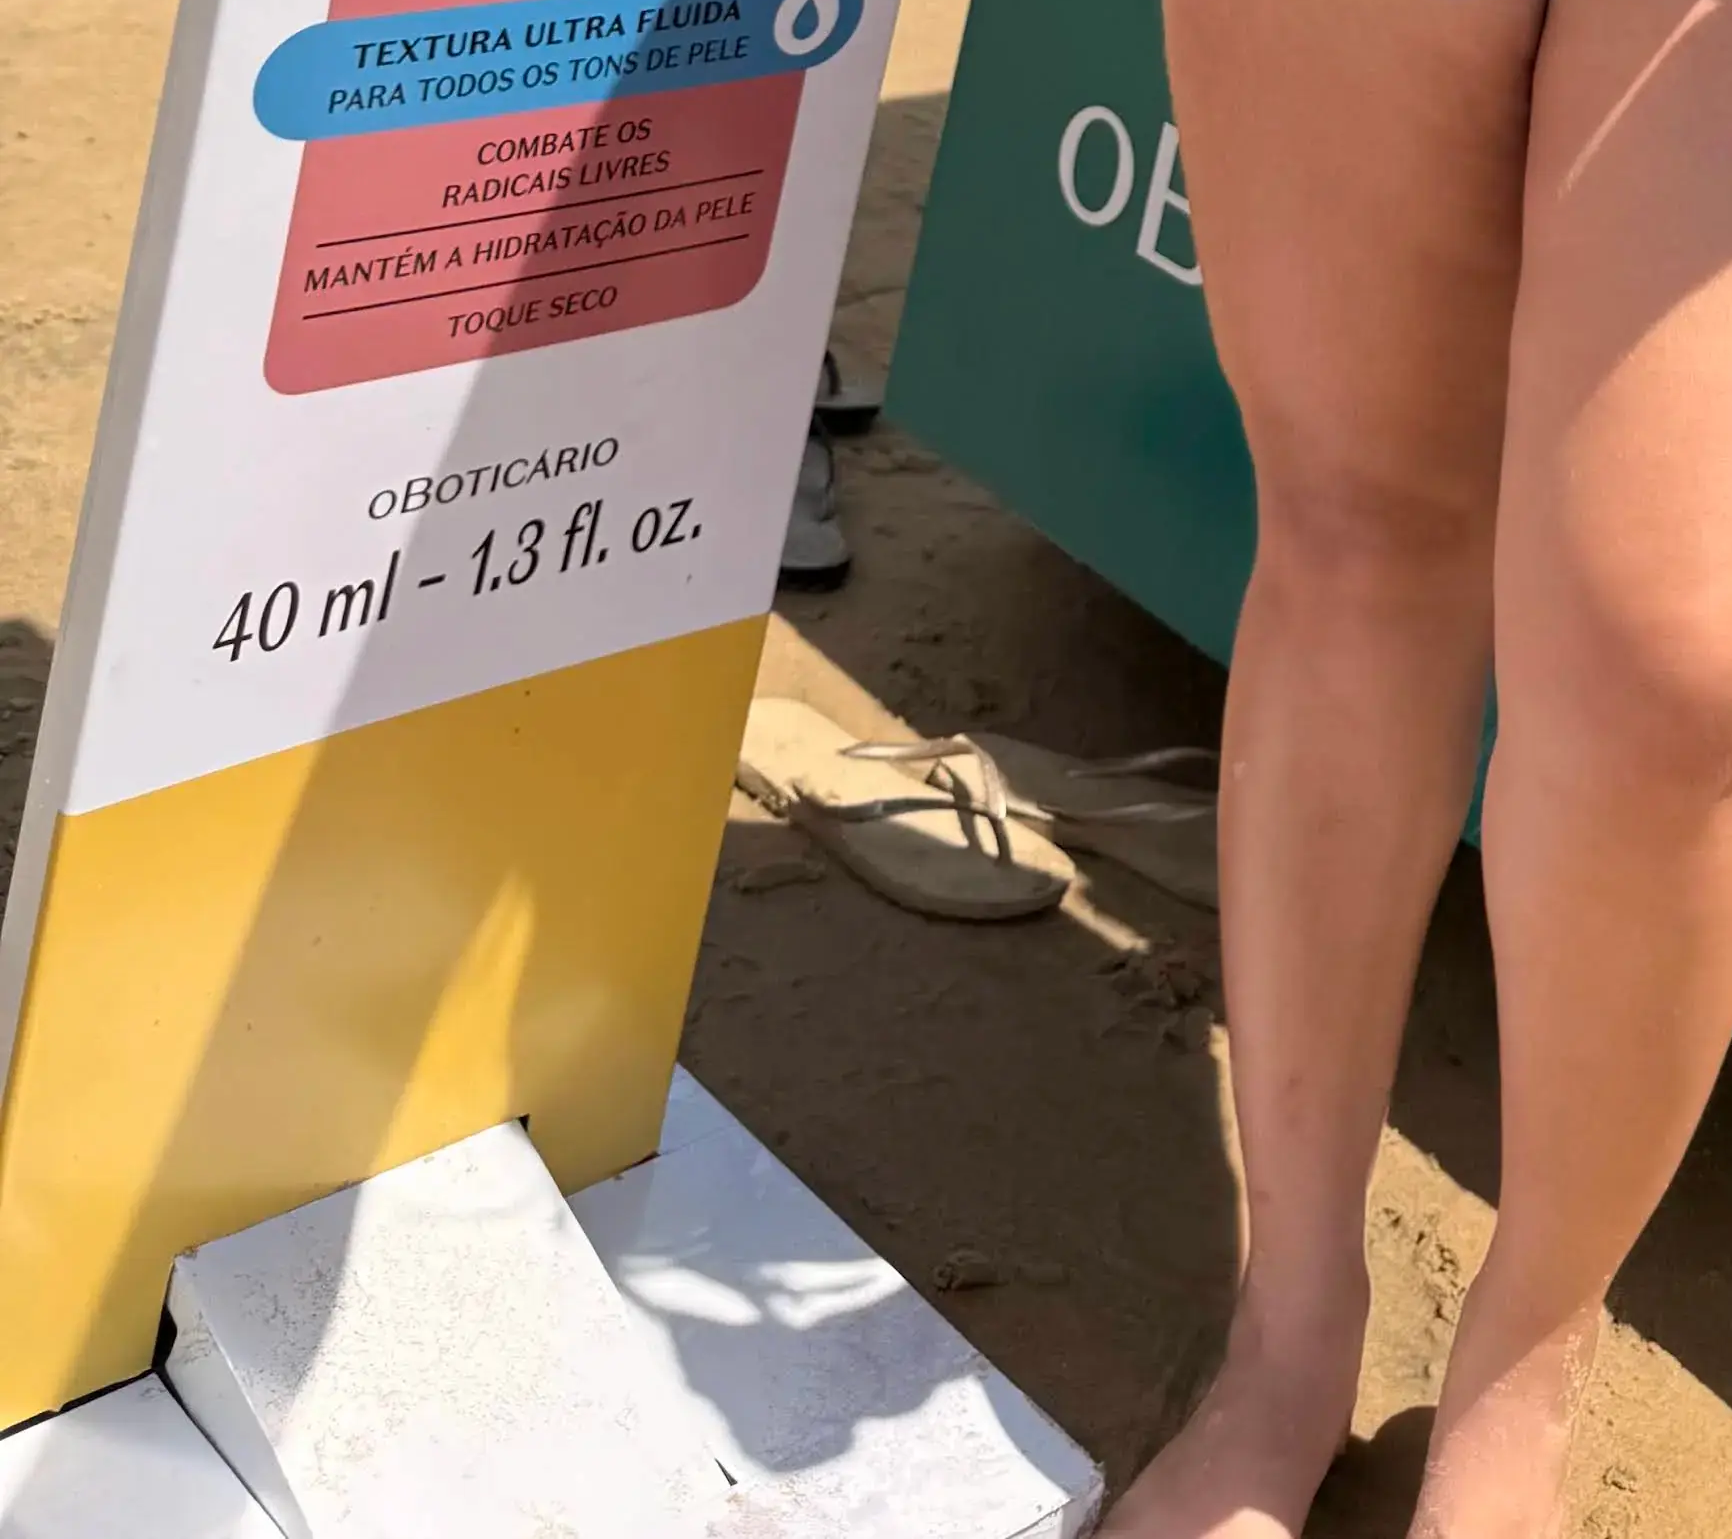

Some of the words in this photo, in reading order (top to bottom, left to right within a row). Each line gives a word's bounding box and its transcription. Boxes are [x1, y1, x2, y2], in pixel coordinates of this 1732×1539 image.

[353, 27, 512, 70] TEXTURA
[523, 13, 626, 50] ULTRA
[326, 77, 407, 115] PARA
[417, 67, 514, 102] TODOS
[522, 62, 560, 89] OS
[569, 49, 640, 82] TONS
[645, 43, 679, 71] DE
[687, 35, 751, 66] PELE
[476, 121, 611, 168] COMBATE
[616, 119, 654, 146] OS
[441, 164, 573, 210] RADICAIS
[579, 150, 671, 187] LIVRES
[302, 246, 438, 294] MANTÉM
[444, 246, 464, 270] A
[471, 212, 648, 268] HIDRATAÇÃO
[652, 205, 689, 233] DA
[694, 192, 756, 223] PELE
[447, 299, 541, 339] TOQUE
[547, 285, 620, 319] SECO
[211, 579, 300, 665] 40
[316, 549, 401, 638] ml
[470, 519, 545, 597] 1.3
[557, 498, 610, 574] fl.
[630, 496, 703, 554] oz.
